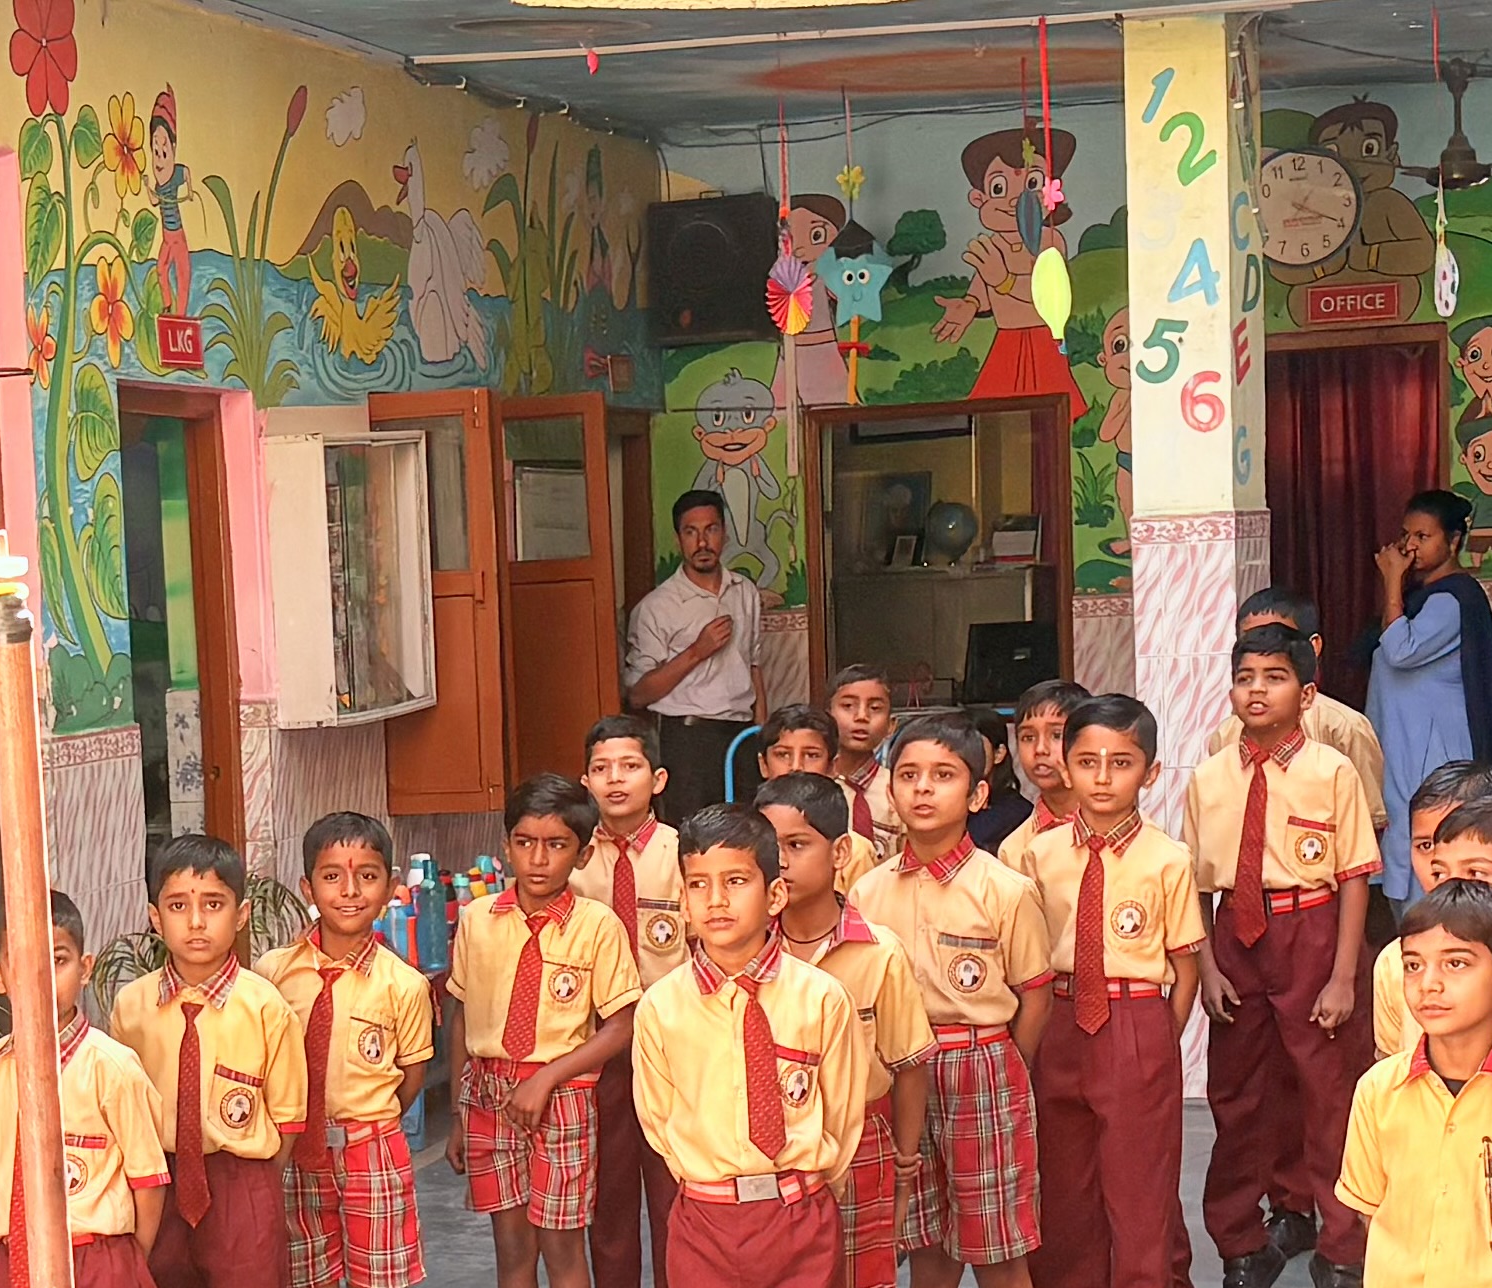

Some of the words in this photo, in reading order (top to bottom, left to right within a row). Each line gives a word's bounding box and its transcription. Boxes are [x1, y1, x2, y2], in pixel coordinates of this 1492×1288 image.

[1142, 67, 1175, 123] 1
[1159, 112, 1217, 186] 2
[1292, 156, 1306, 171] 12
[1317, 160, 1324, 174] 1
[1272, 165, 1284, 180] 11
[1332, 172, 1342, 187] 2
[1342, 194, 1352, 207] 3
[1232, 191, 1250, 251] C
[1278, 240, 1287, 255] 7
[1300, 243, 1310, 257] 6
[1322, 234, 1331, 249] 5
[1168, 238, 1220, 305] 4
[1242, 254, 1261, 312] D
[1320, 293, 1386, 313] OFFICE
[1136, 319, 1189, 384] 5
[1233, 318, 1251, 387] E
[1181, 371, 1225, 433] 6
[1235, 425, 1251, 486] G
